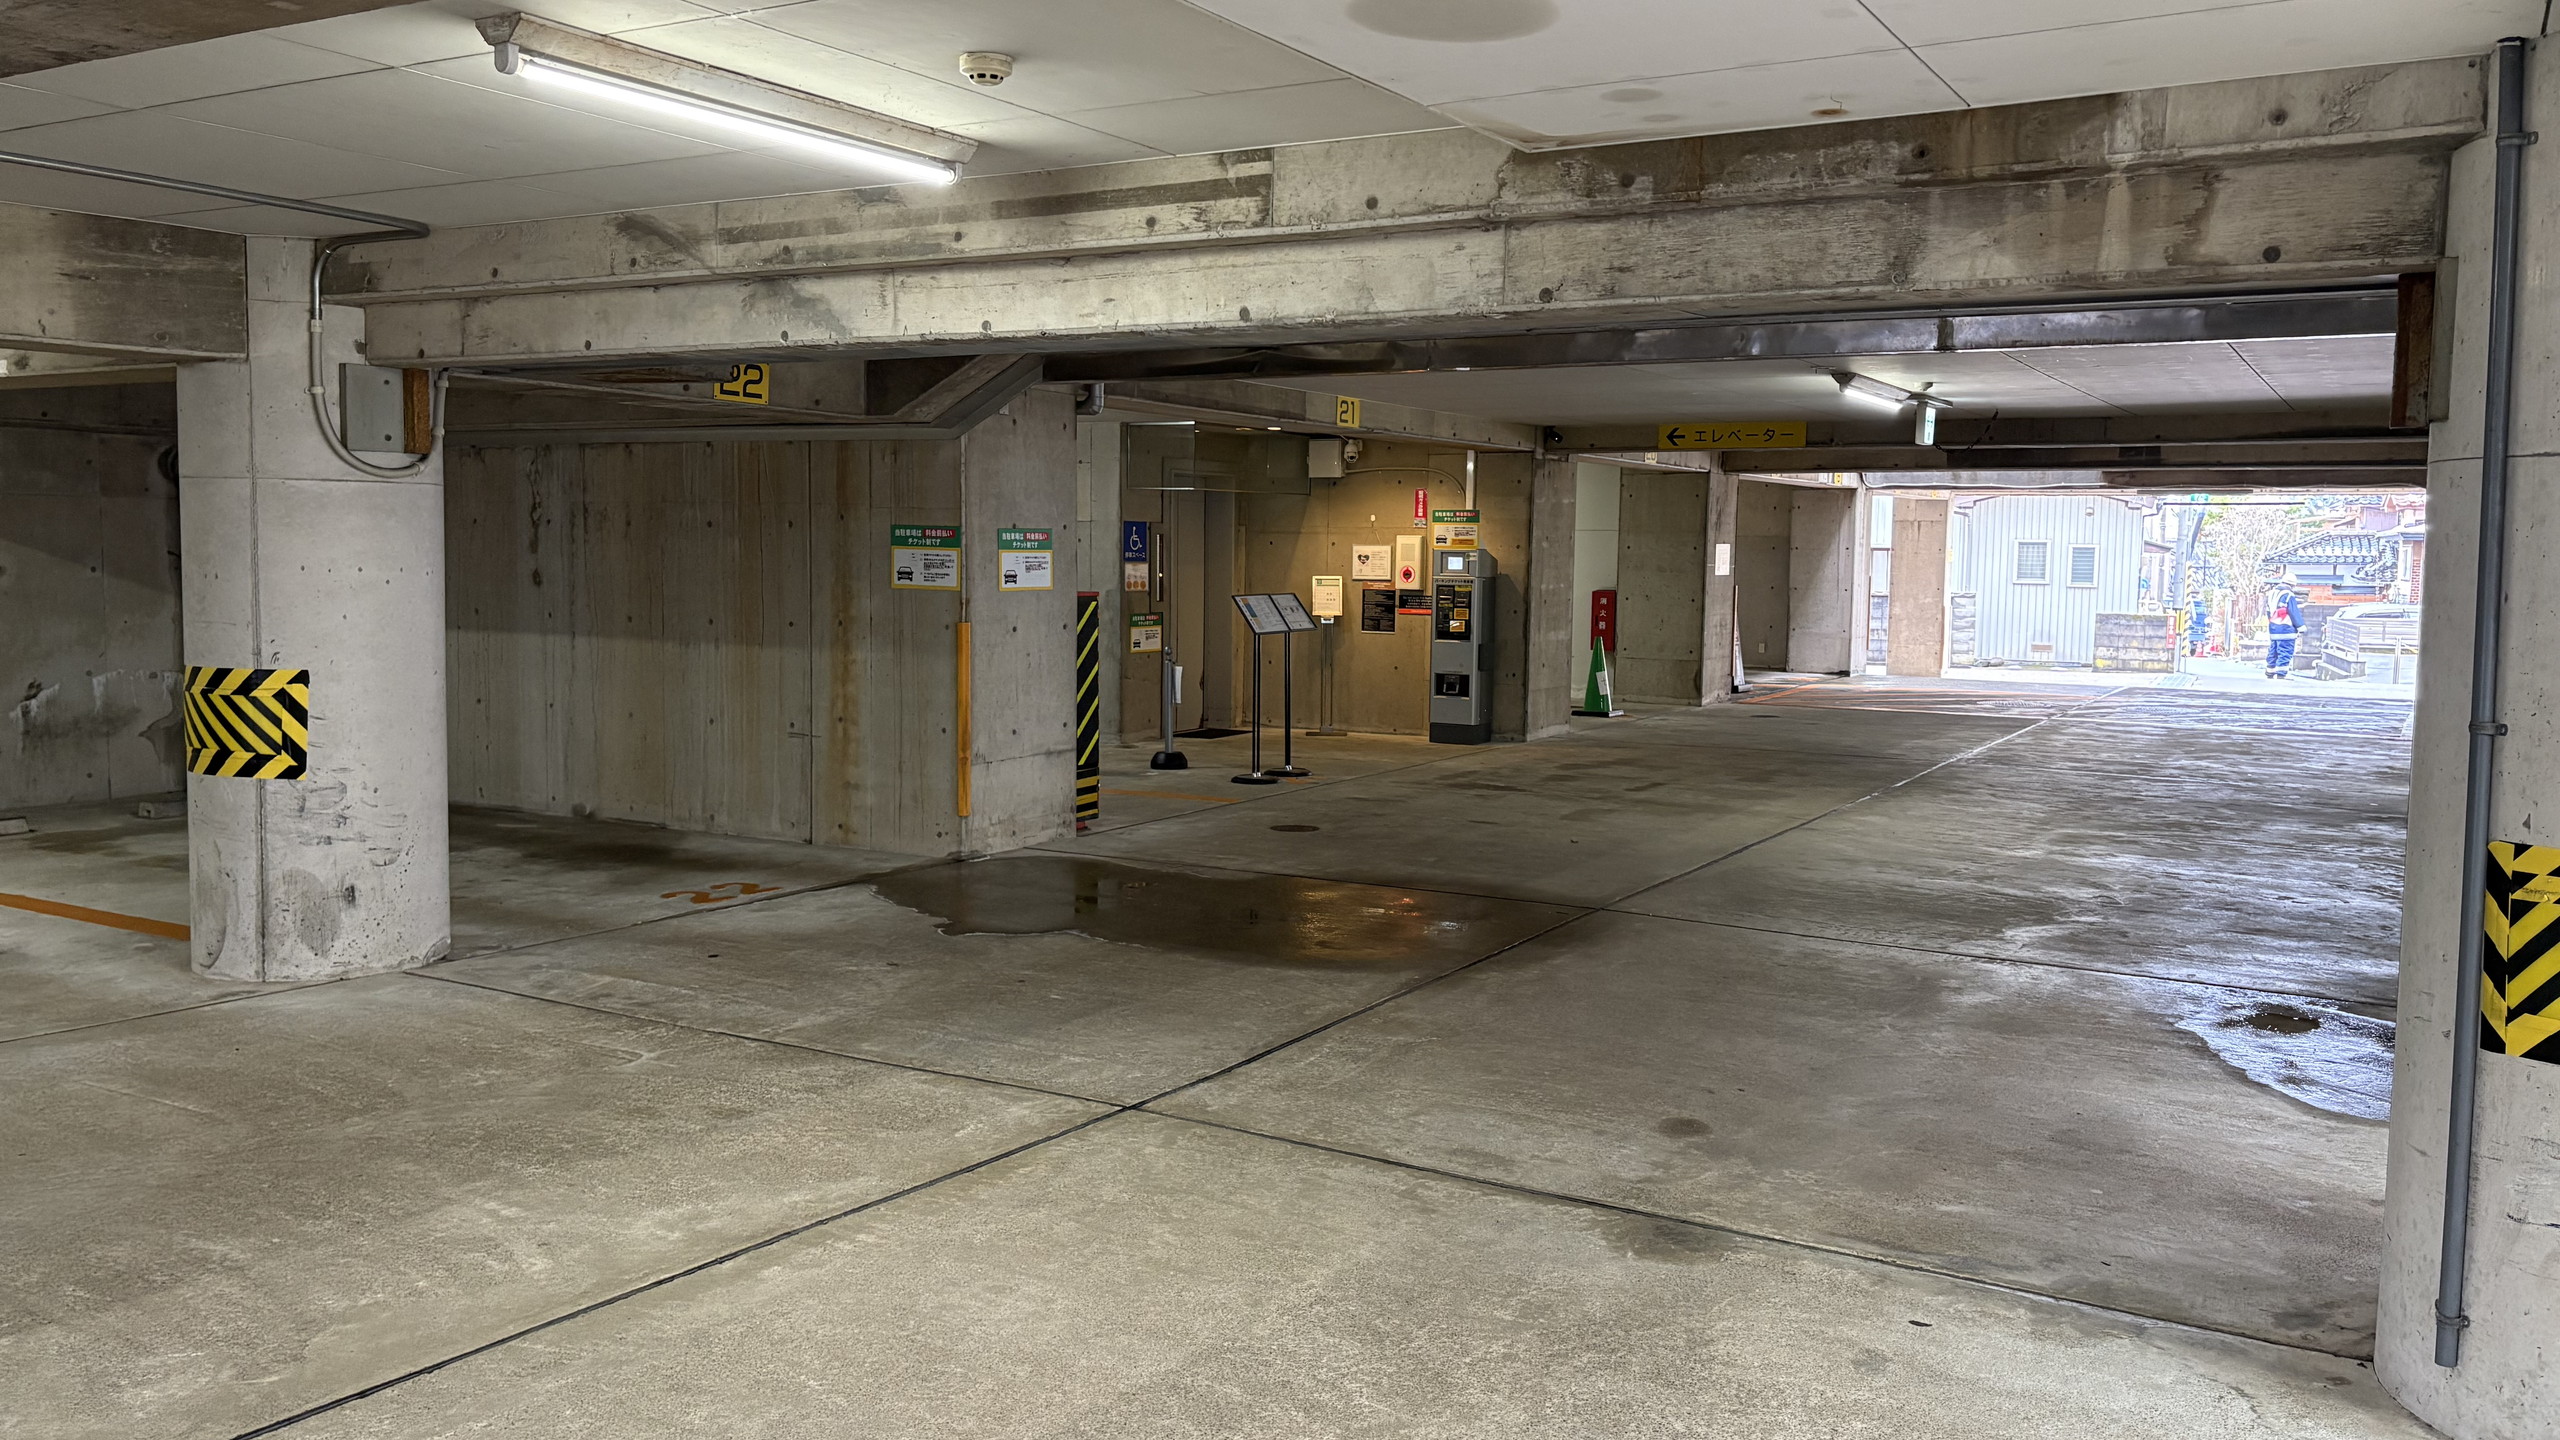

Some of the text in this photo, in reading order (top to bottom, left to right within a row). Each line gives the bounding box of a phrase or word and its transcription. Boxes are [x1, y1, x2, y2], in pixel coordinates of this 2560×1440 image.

[720, 363, 763, 399] 22
[1340, 400, 1355, 424] 21
[1693, 428, 1794, 442] エレベーター
[1598, 597, 1608, 630] 消火器
[660, 882, 784, 905] 22
